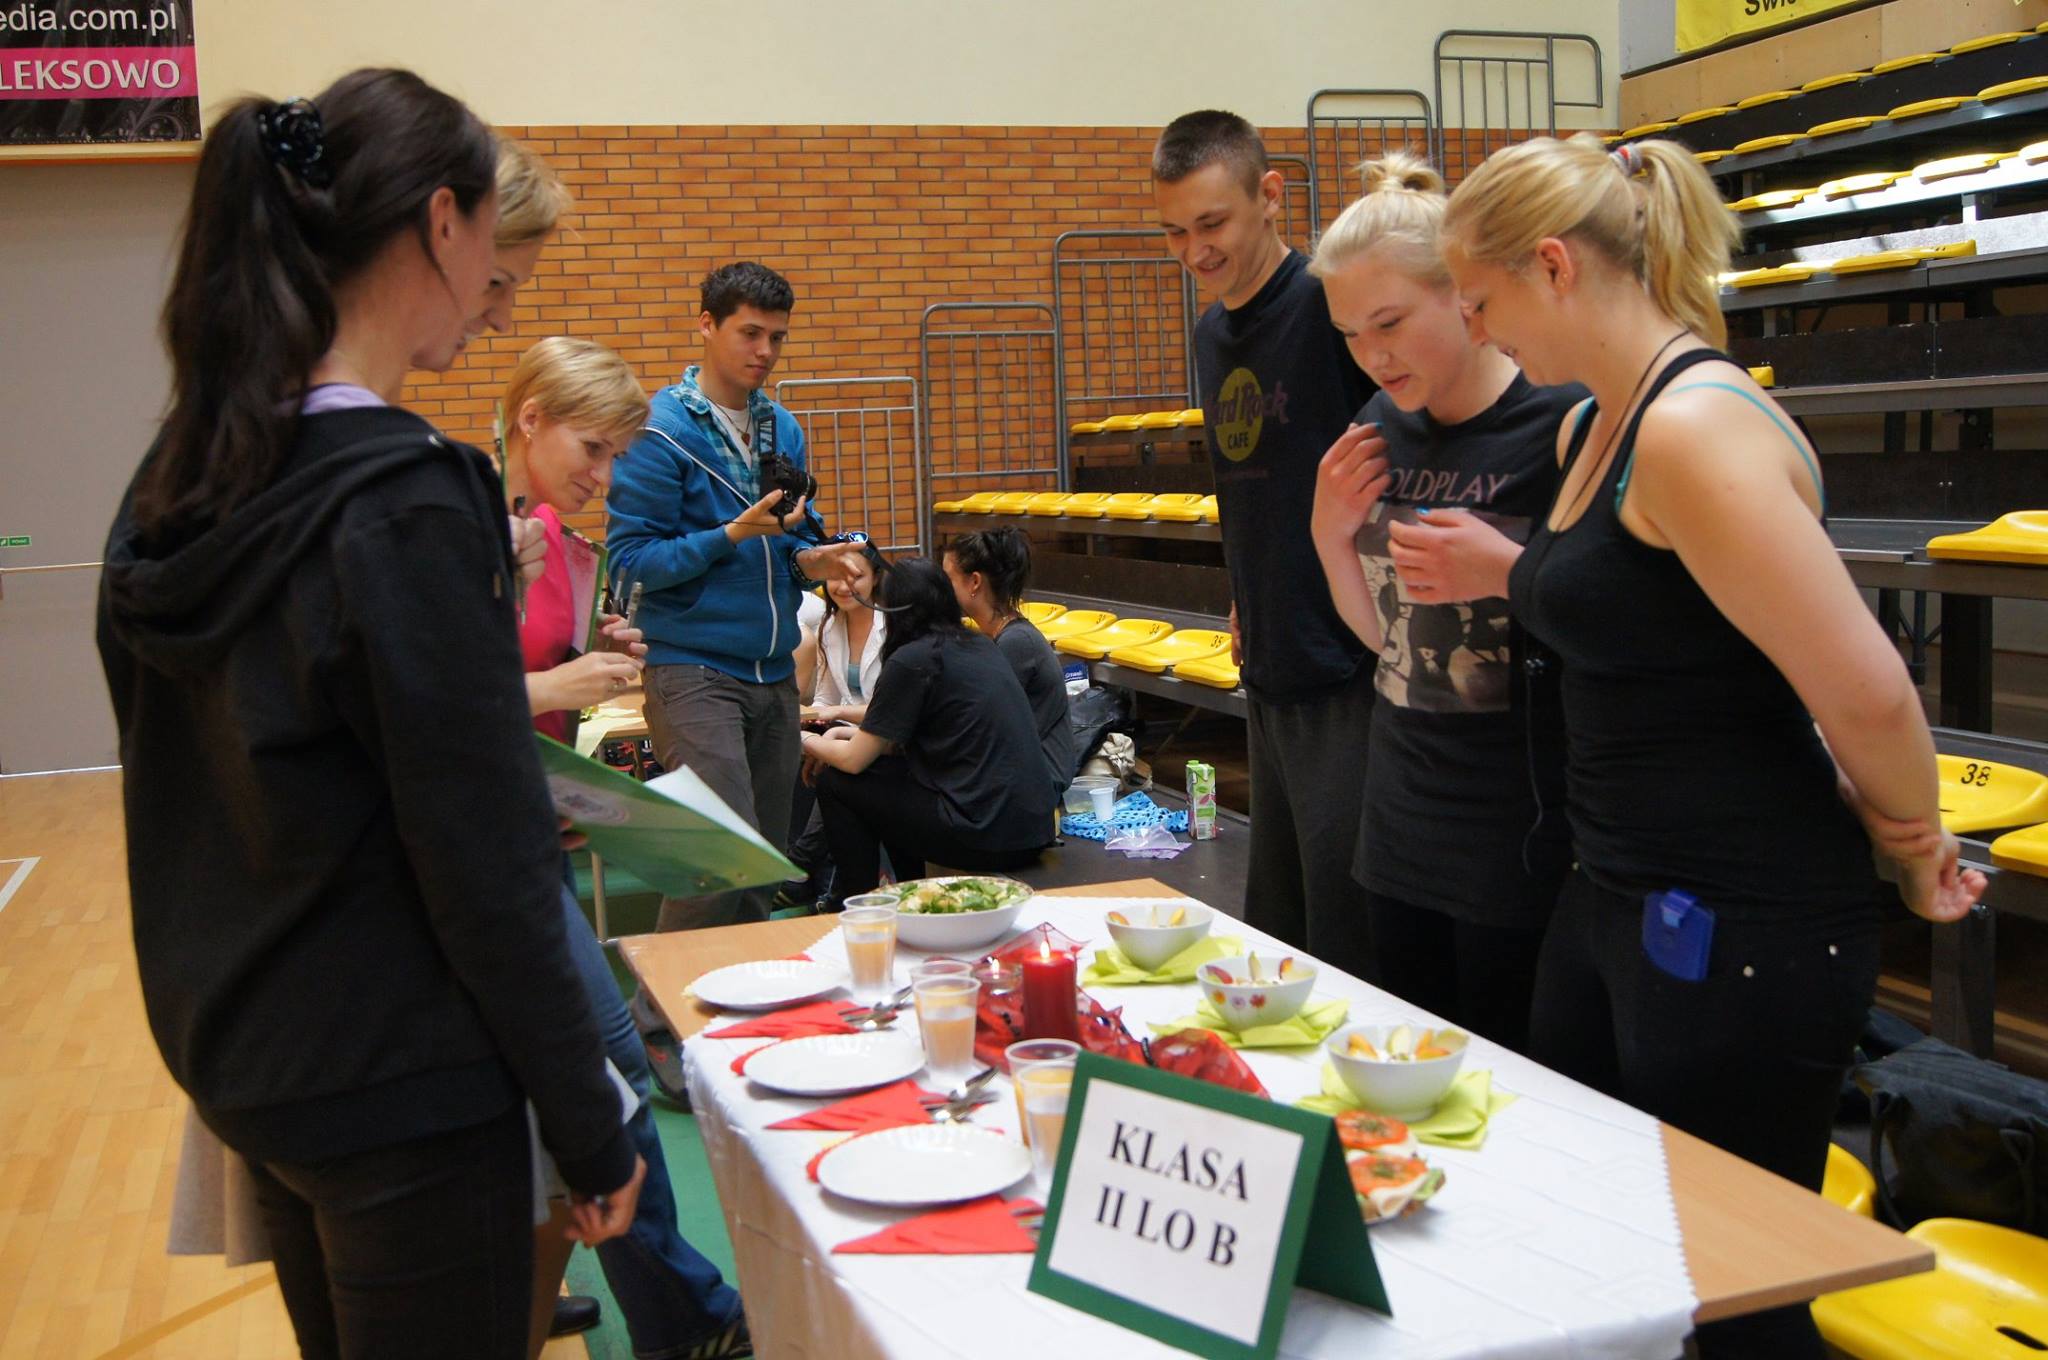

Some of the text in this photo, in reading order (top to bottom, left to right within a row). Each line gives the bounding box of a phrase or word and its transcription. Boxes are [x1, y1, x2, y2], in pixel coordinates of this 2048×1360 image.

[1227, 432, 1249, 450] CAFE
[1383, 467, 1509, 503] OLDPLAY
[1960, 762, 1992, 787] 38
[1109, 1120, 1249, 1202] KLASA
[1095, 1185, 1238, 1268] II LO B
